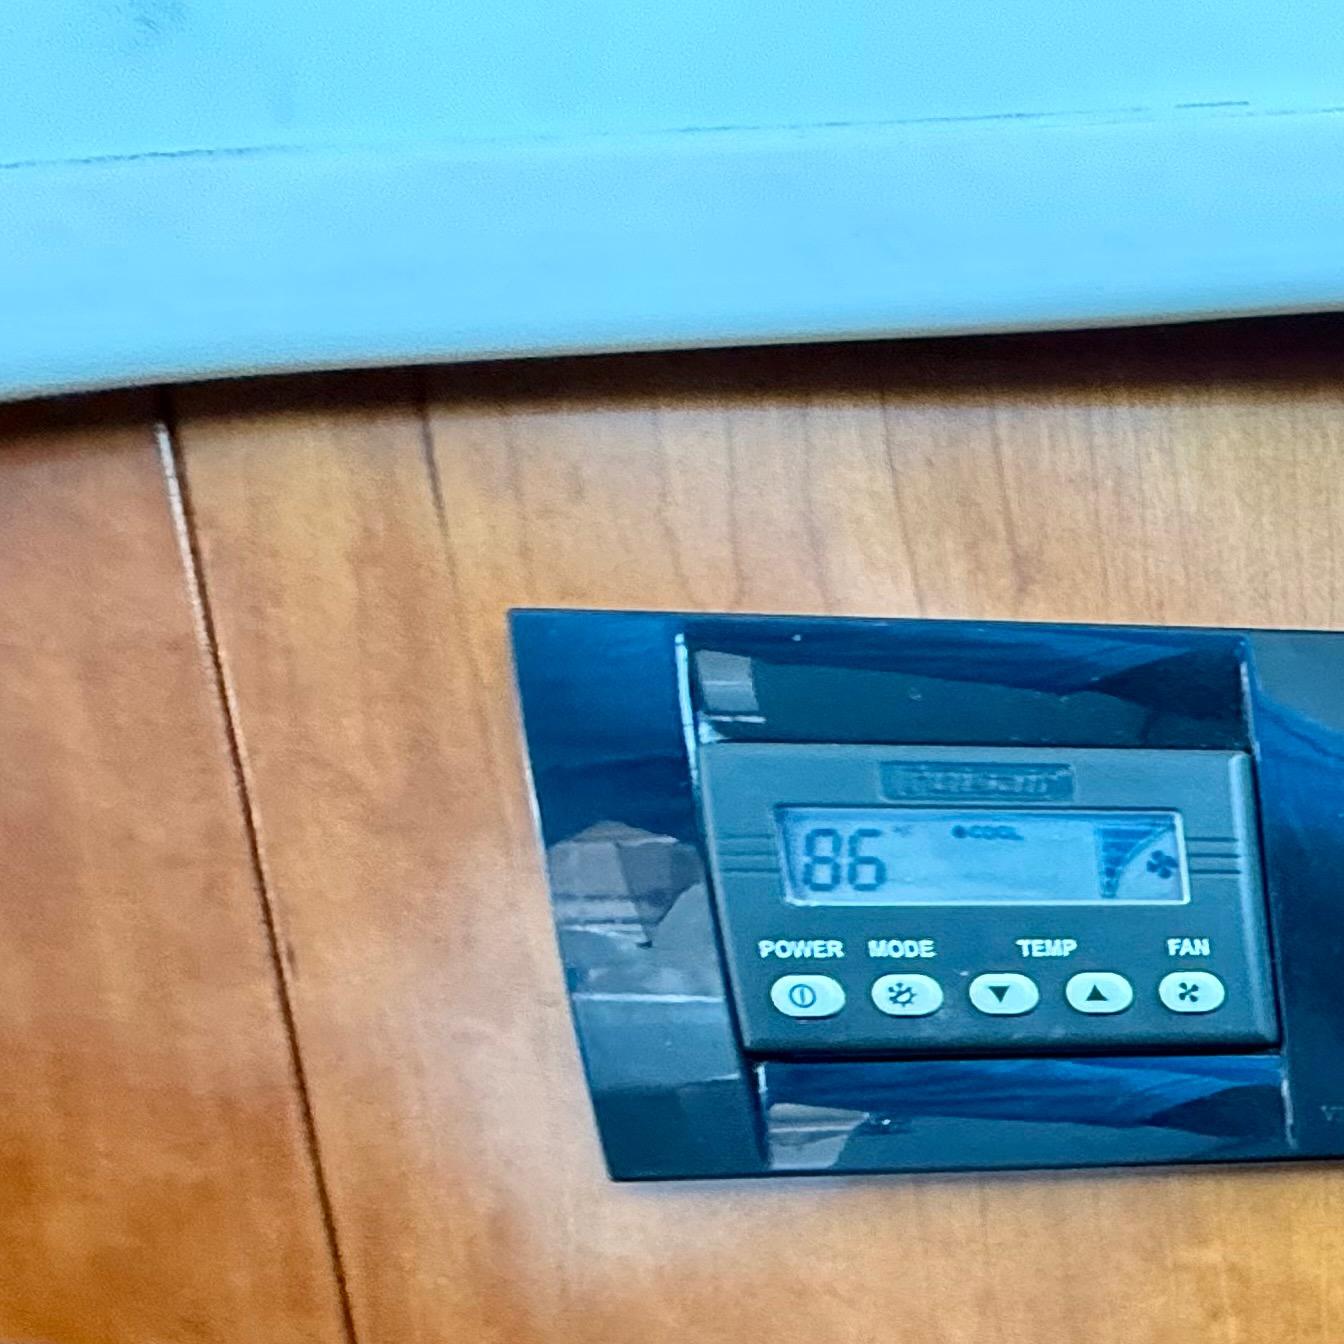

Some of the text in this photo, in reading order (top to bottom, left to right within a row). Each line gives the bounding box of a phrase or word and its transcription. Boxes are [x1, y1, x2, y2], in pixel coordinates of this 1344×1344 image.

[803, 827, 887, 892] 86
[758, 937, 1211, 960] POWER MODE TEMP FAN
